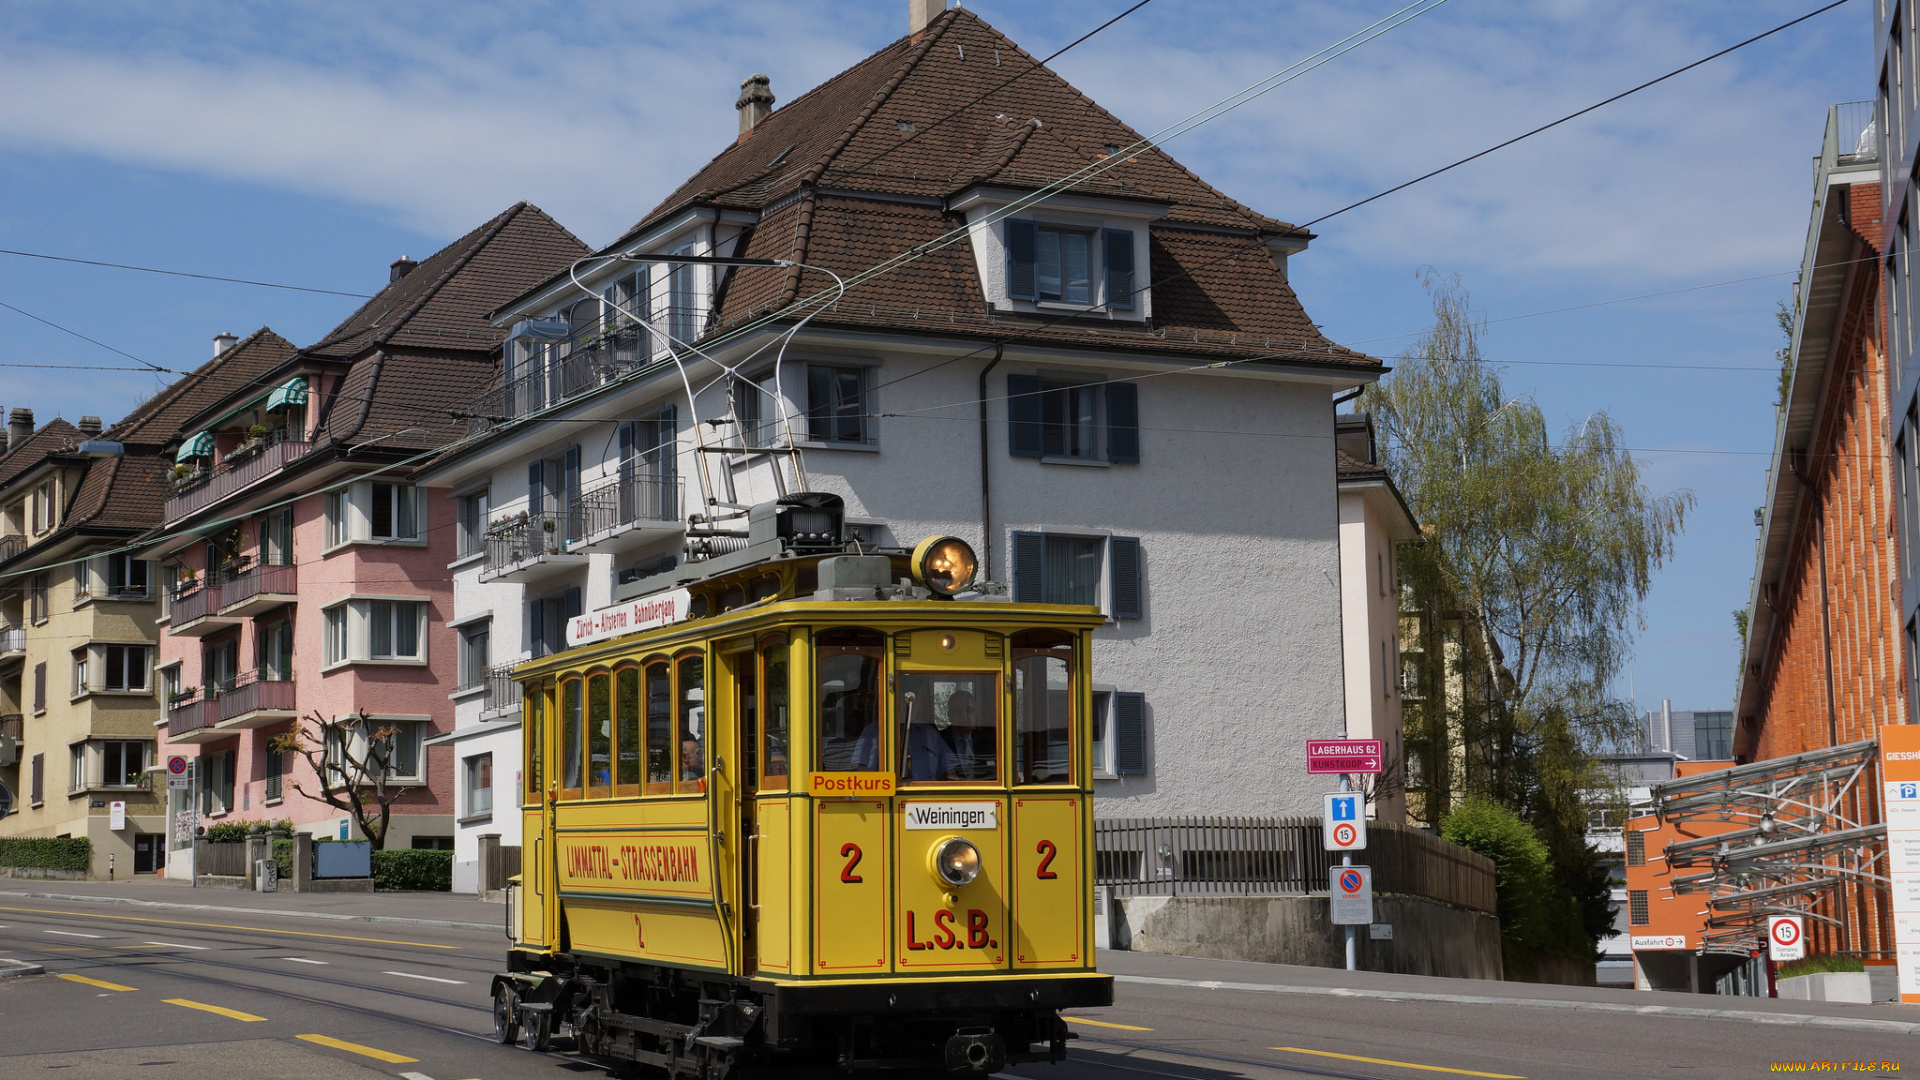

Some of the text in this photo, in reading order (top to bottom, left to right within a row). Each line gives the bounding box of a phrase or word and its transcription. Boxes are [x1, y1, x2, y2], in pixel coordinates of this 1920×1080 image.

[634, 597, 675, 625] Bahnübergang
[1312, 745, 1376, 755] LAGERHAUS 62
[1313, 760, 1362, 769] KUNSTKOOP
[813, 775, 891, 791] Postkurs
[916, 807, 985, 827] Weiningen
[1340, 829, 1349, 840] 15
[840, 842, 863, 884] 2
[1036, 840, 1058, 880] 2
[634, 914, 645, 949] 2
[906, 909, 998, 950] L.S.B.
[1781, 927, 1792, 939] 15
